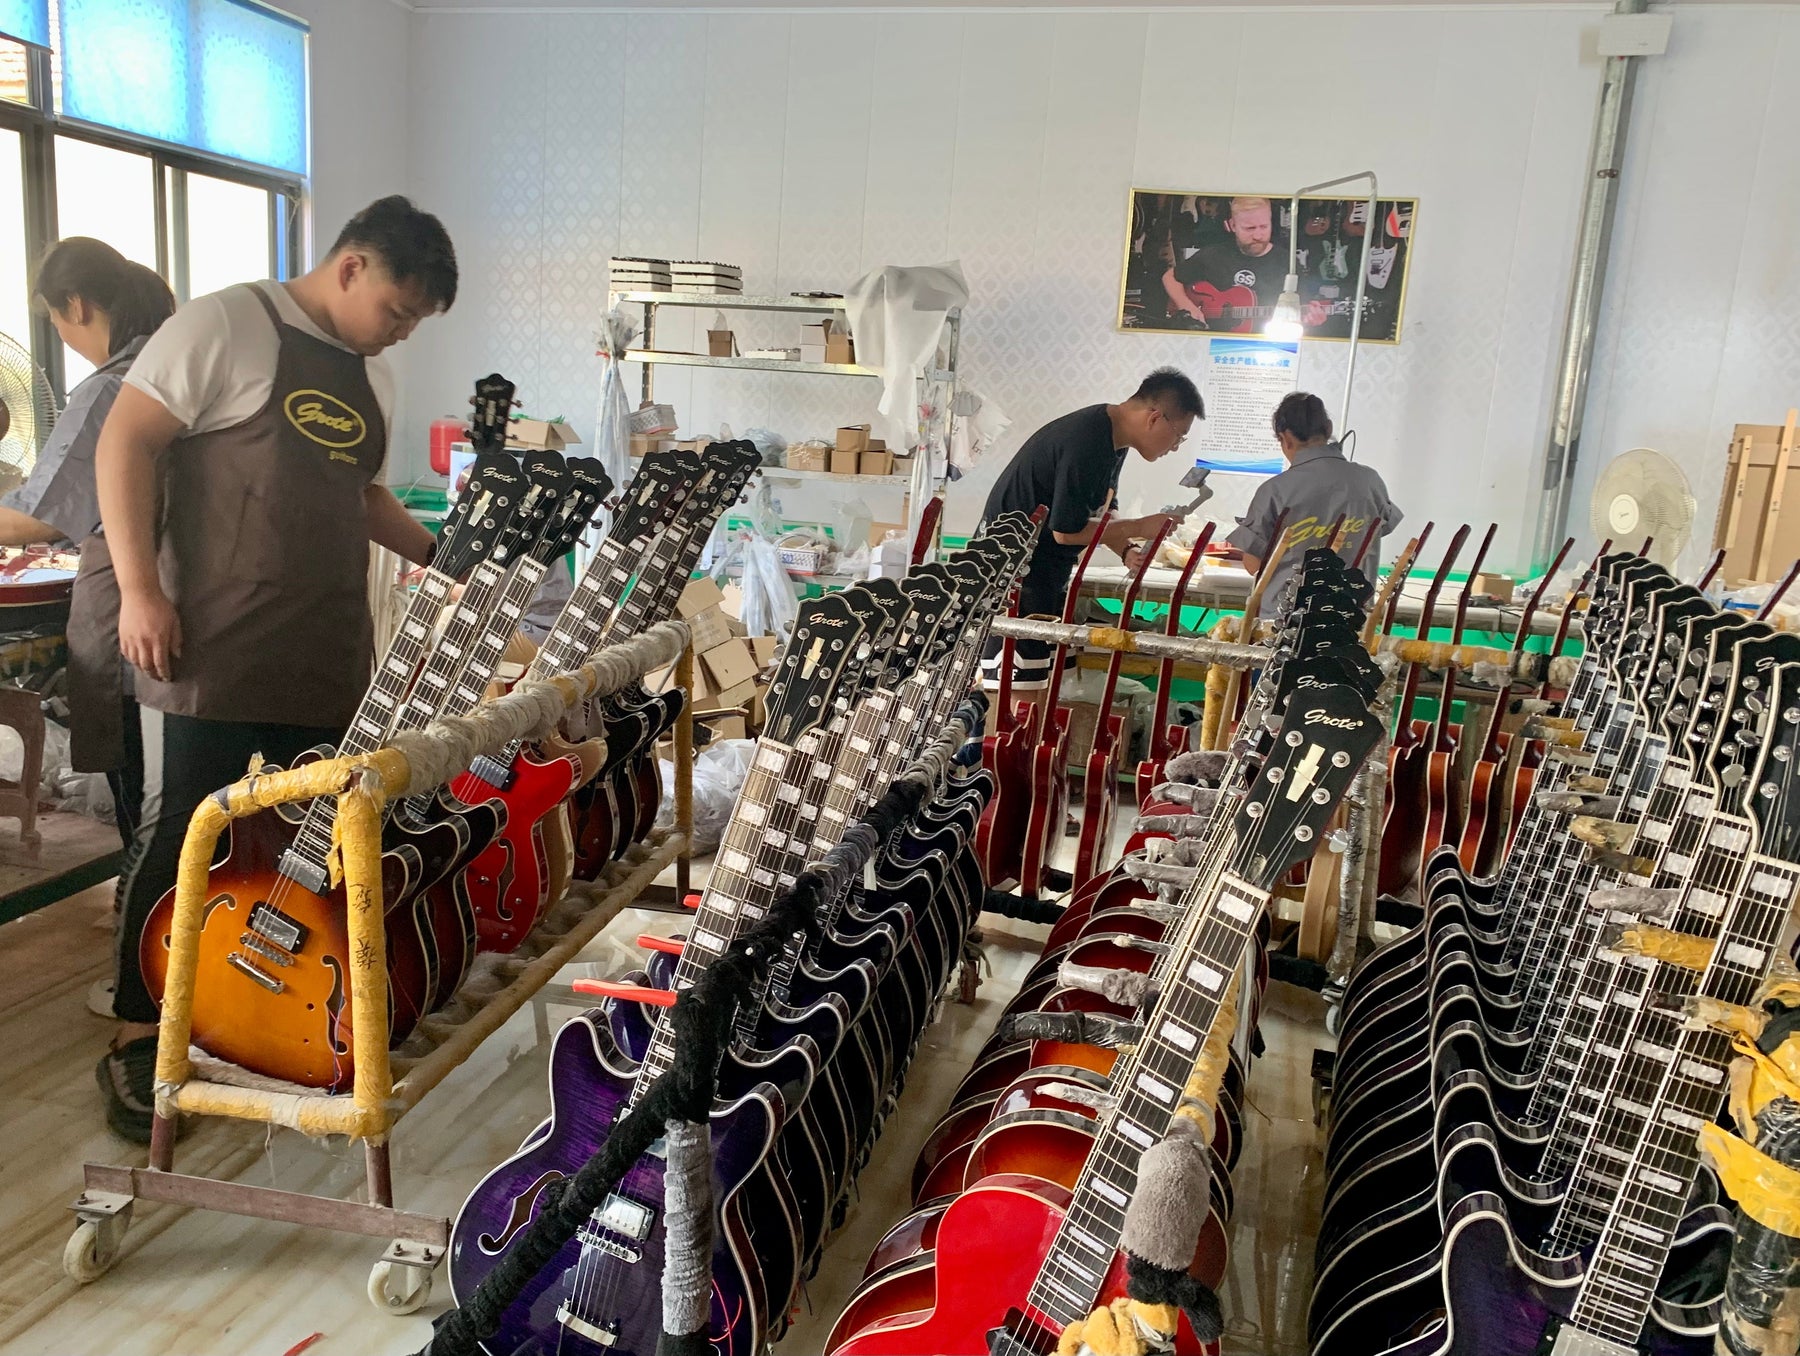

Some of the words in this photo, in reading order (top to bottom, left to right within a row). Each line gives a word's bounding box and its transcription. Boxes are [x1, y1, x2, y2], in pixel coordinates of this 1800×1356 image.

[1237, 273, 1253, 285] GS
[871, 593, 896, 607] rote
[809, 612, 844, 628] Grote
[1304, 709, 1358, 730] Grote
